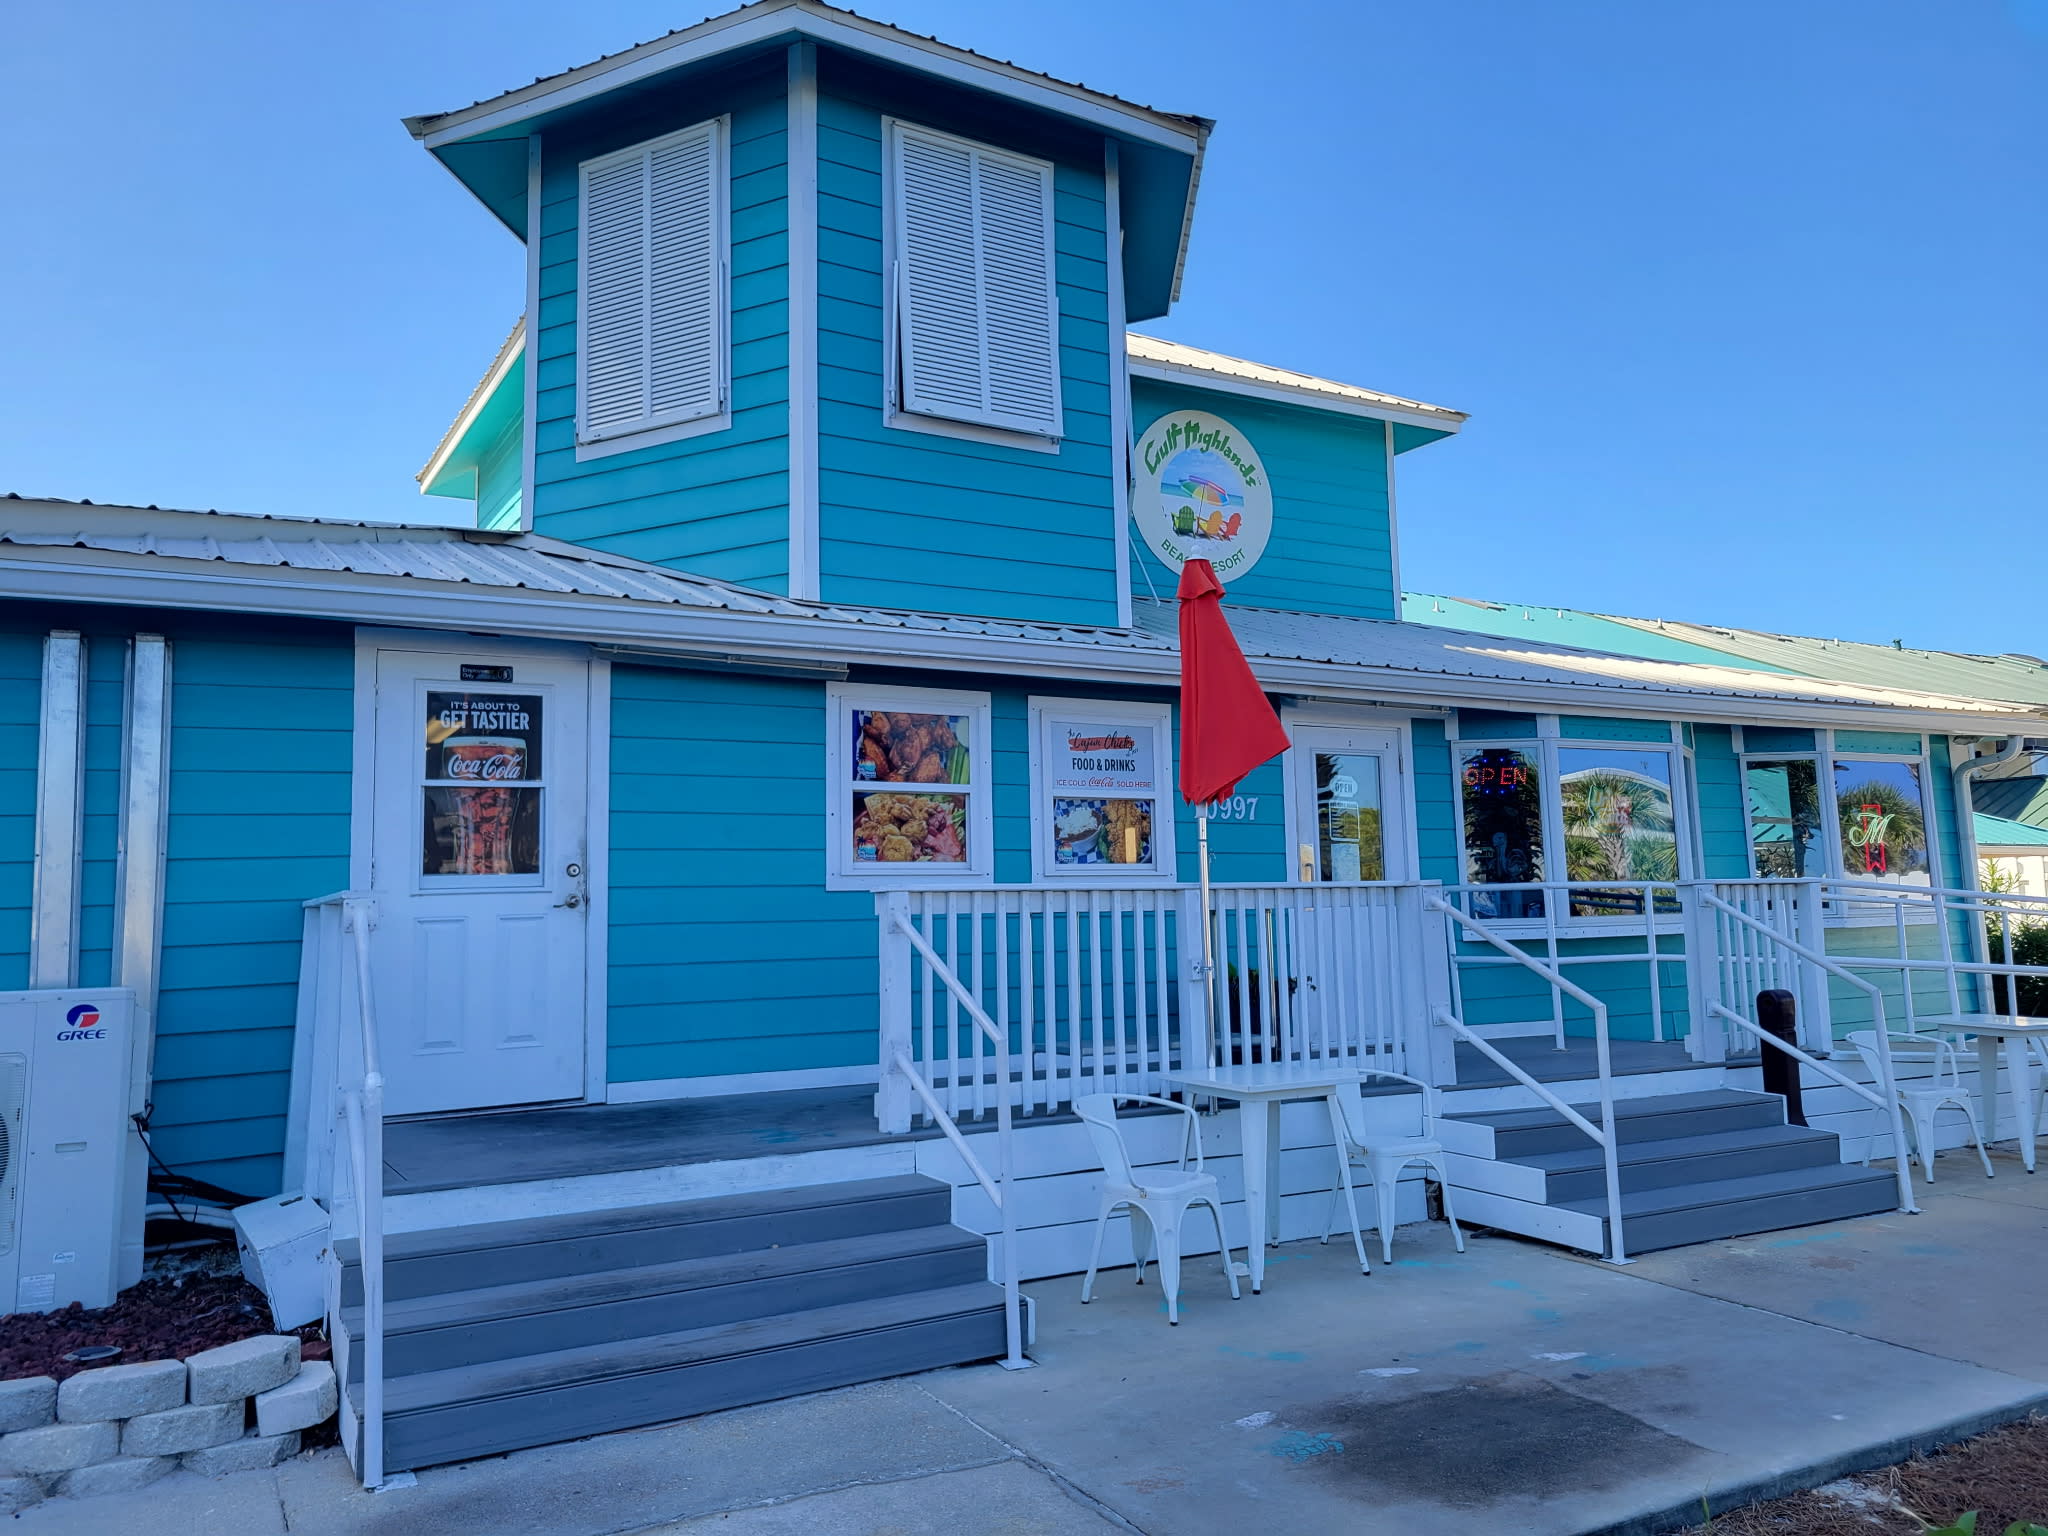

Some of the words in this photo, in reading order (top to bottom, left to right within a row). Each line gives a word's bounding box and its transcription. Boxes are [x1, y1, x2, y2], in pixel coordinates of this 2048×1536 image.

[1144, 422, 1182, 476] Gulf
[1183, 420, 1256, 487] Highlands
[1161, 538, 1189, 564] BEA
[1211, 547, 1246, 573] ESORT
[450, 701, 470, 711] IT'S
[471, 702, 505, 711] ABOUT
[506, 703, 520, 712] TO
[440, 710, 466, 729] GET
[471, 711, 530, 731] TASTIER
[1072, 758, 1095, 771] FOOD
[1097, 759, 1103, 771] &
[1104, 760, 1136, 772] DRINKS
[1068, 779, 1087, 787] COLD
[1116, 780, 1134, 788] SOLD
[1134, 781, 1152, 789] HERE
[1334, 782, 1353, 793] OPEN
[1194, 796, 1259, 821] 0997
[56, 1029, 107, 1041] GREE
